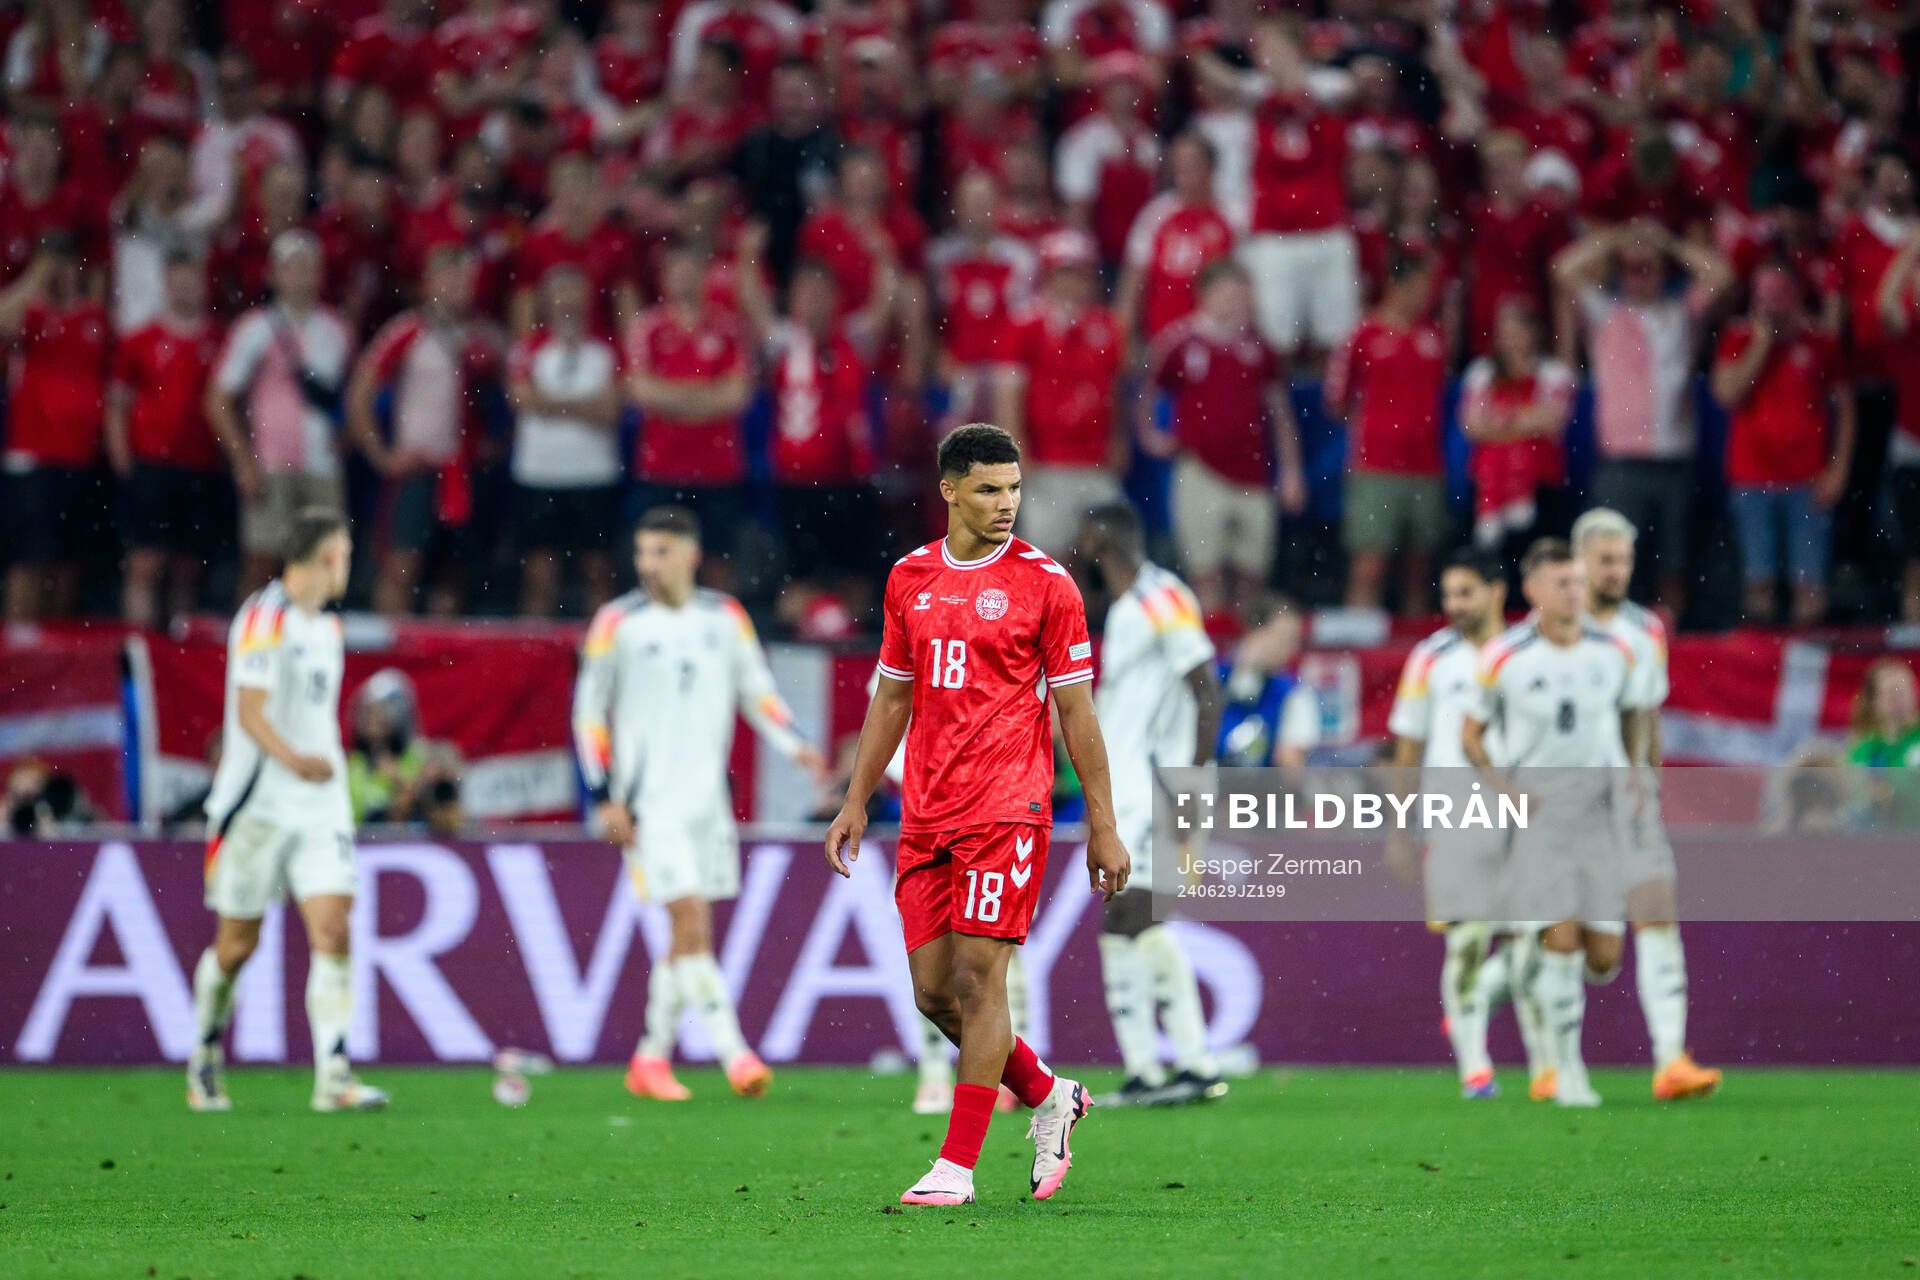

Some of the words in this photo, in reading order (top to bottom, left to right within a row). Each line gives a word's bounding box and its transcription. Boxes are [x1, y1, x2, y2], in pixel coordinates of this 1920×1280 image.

[982, 598, 1002, 610] DBU
[930, 638, 966, 689] 18
[964, 870, 1004, 922] 18
